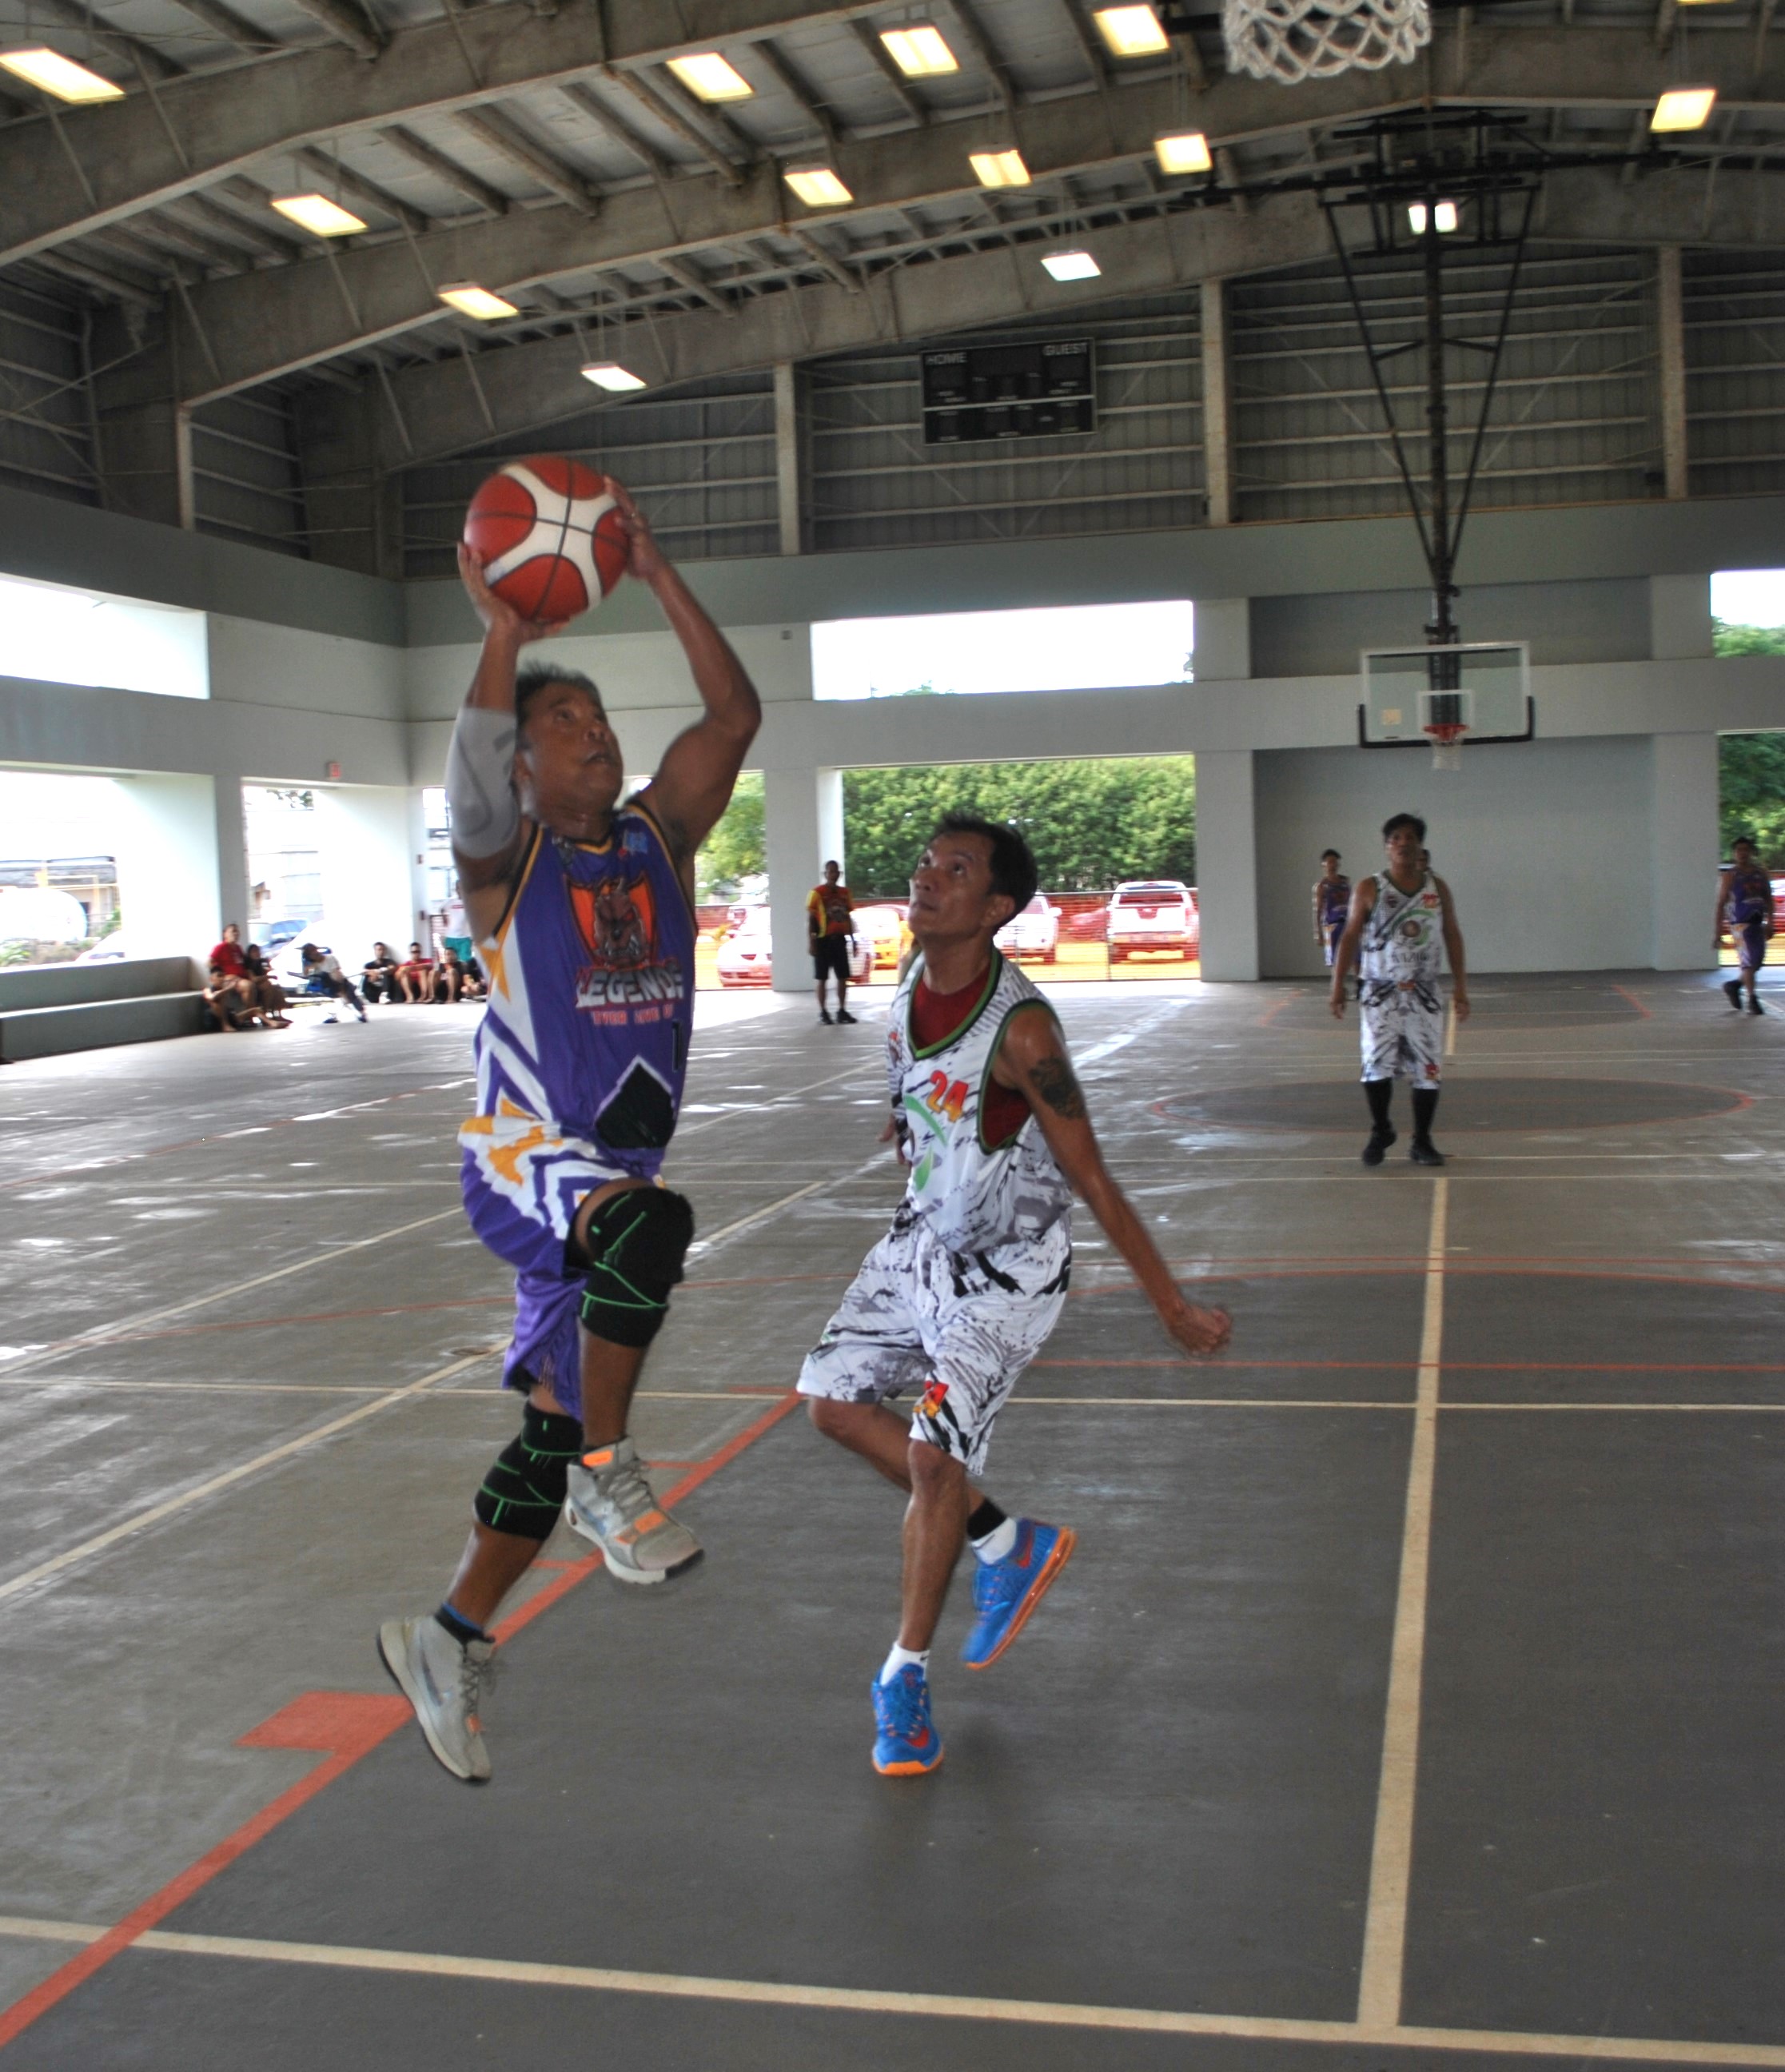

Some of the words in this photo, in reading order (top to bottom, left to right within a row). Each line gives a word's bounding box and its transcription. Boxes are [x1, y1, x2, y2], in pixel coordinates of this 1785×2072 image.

[1042, 342, 1088, 356] GUEST
[926, 352, 968, 365] HOME
[926, 1070, 969, 1122] 24
